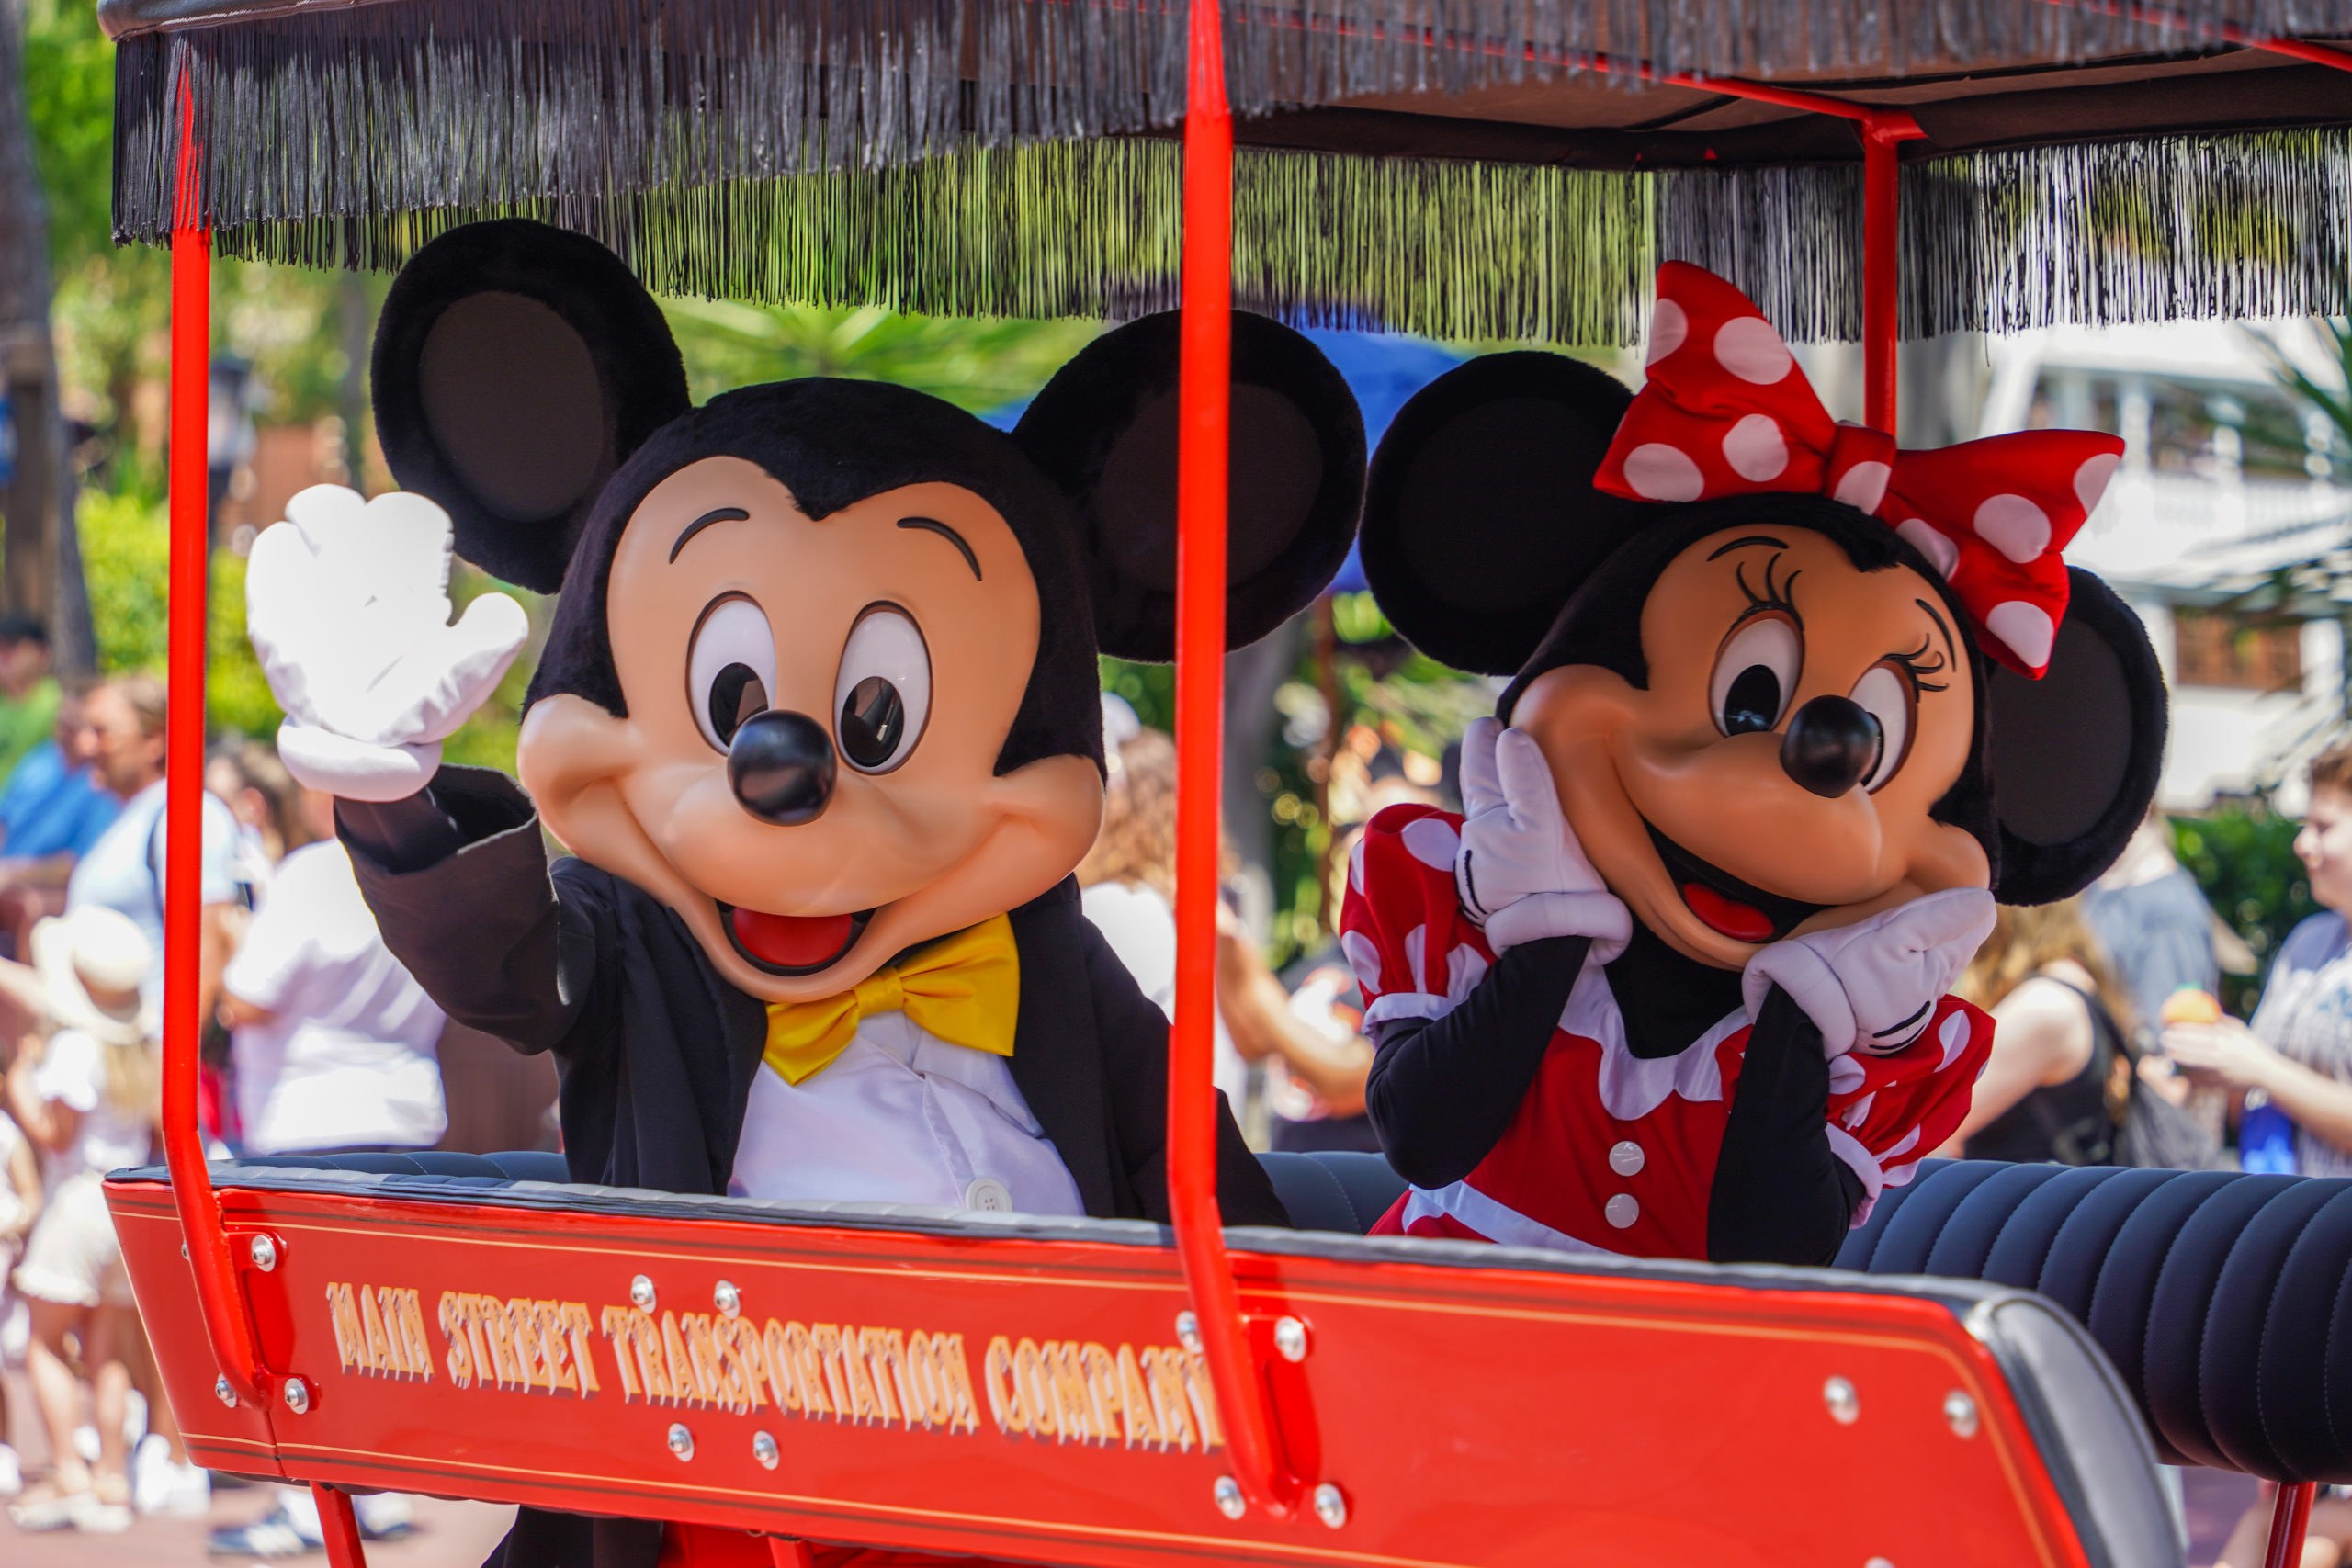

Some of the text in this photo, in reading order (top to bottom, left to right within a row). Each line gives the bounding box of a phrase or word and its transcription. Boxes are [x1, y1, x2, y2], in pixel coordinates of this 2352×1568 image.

[325, 1281, 1227, 1454] MAIN STREET TRANSPORTATION COMPANY
